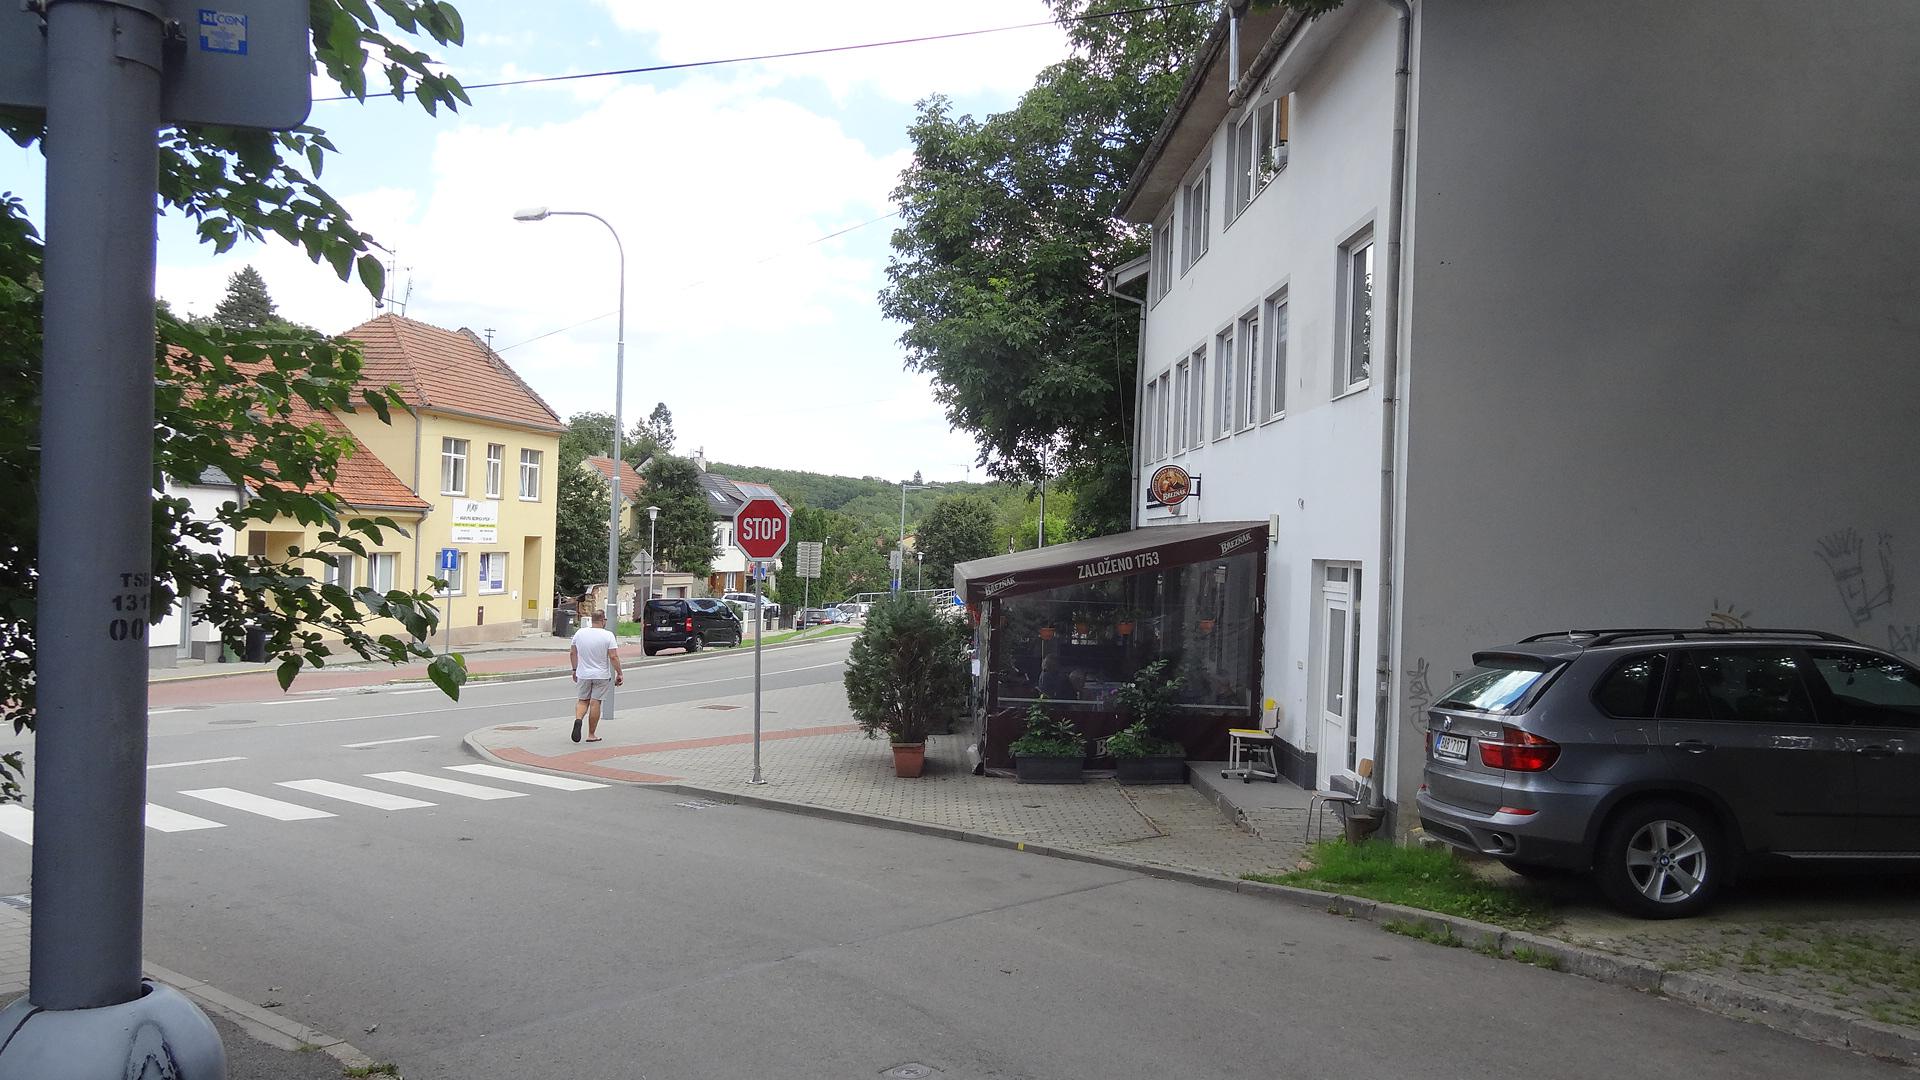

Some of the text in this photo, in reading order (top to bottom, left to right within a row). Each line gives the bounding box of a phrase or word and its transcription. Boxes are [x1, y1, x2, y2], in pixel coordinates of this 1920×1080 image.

[743, 517, 782, 540] STOP
[1077, 551, 1160, 579] ZALOŽENO 1753
